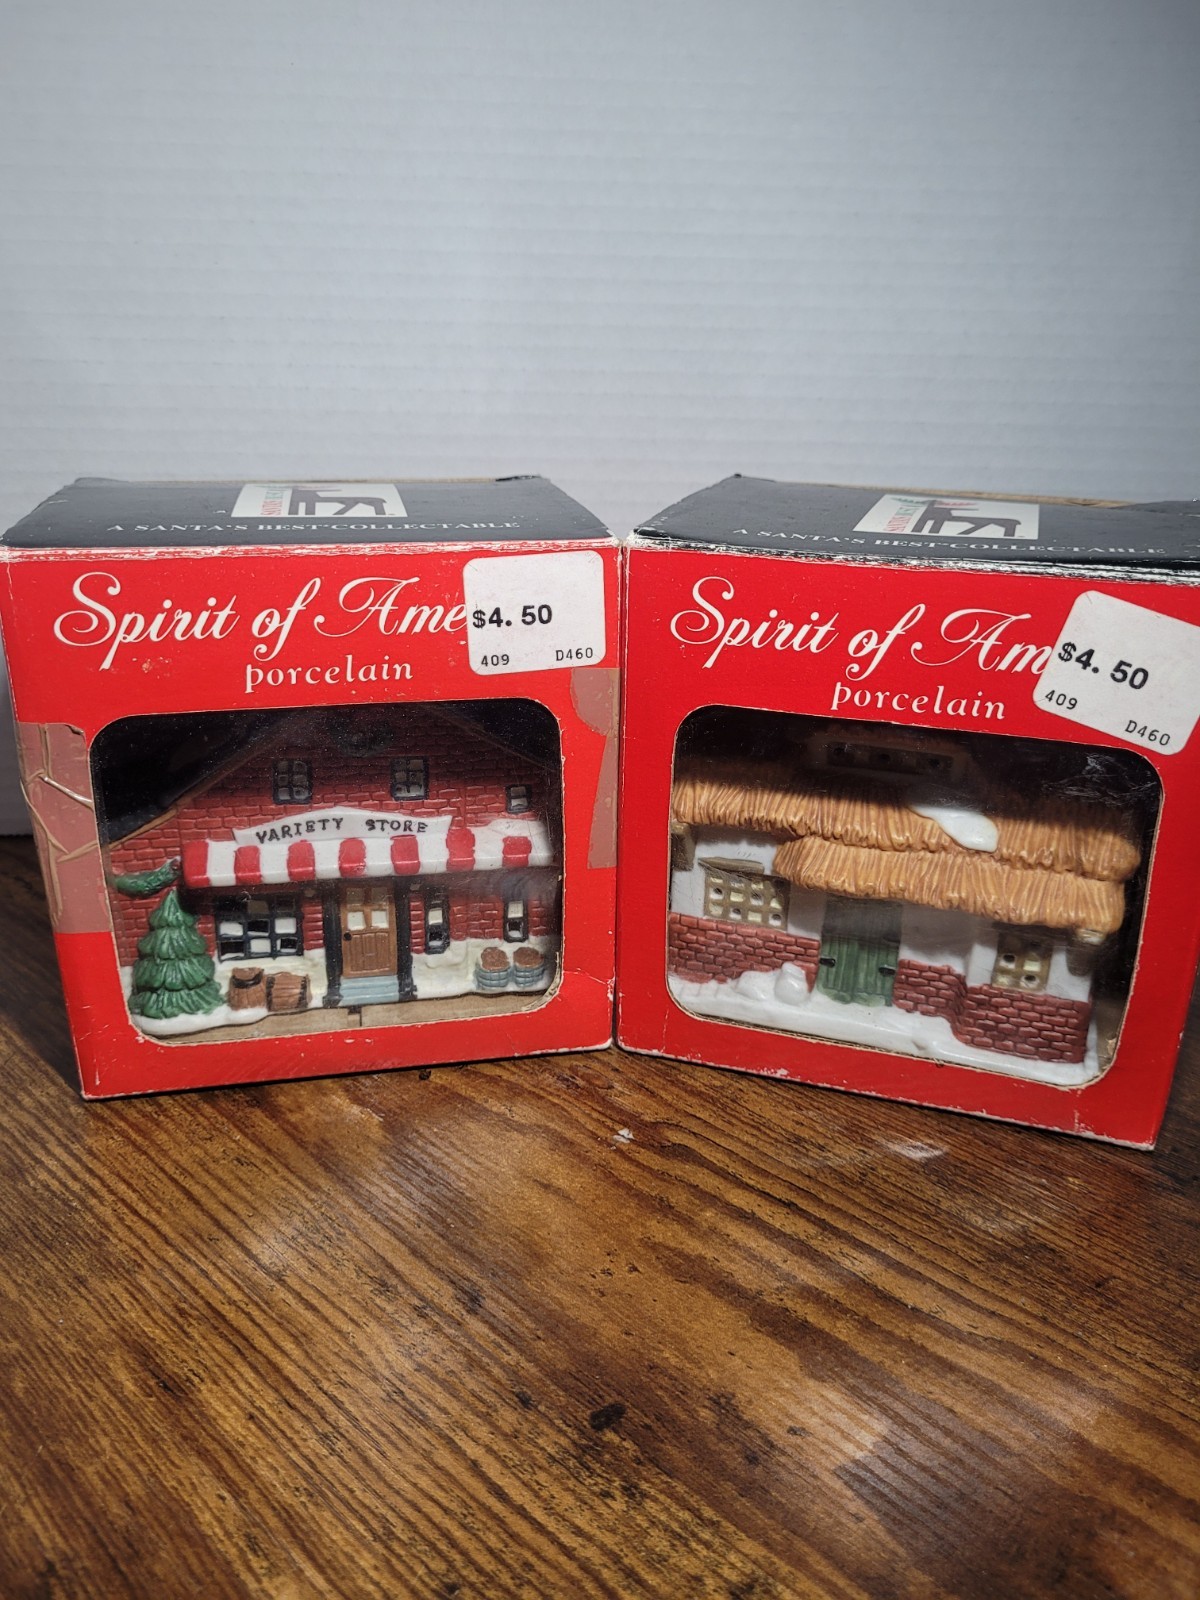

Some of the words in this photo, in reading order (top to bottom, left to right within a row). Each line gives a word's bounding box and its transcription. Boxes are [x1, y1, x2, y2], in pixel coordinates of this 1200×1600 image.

[331, 521, 520, 531] COLLECTABLE
[757, 531, 866, 544] SANTA'S
[53, 571, 241, 671] Spirit
[251, 577, 321, 662] of
[313, 576, 467, 637] Ame
[670, 576, 840, 669] Spirit
[845, 603, 926, 681] of
[910, 608, 1053, 675] Am
[245, 654, 413, 694] porcelain
[480, 653, 510, 667] 409
[555, 647, 594, 662] D460
[830, 681, 1005, 720] porcelain
[1045, 689, 1078, 711] 409
[1124, 719, 1171, 747] D460
[255, 817, 344, 844] VARIETY
[365, 818, 428, 833] STORE
